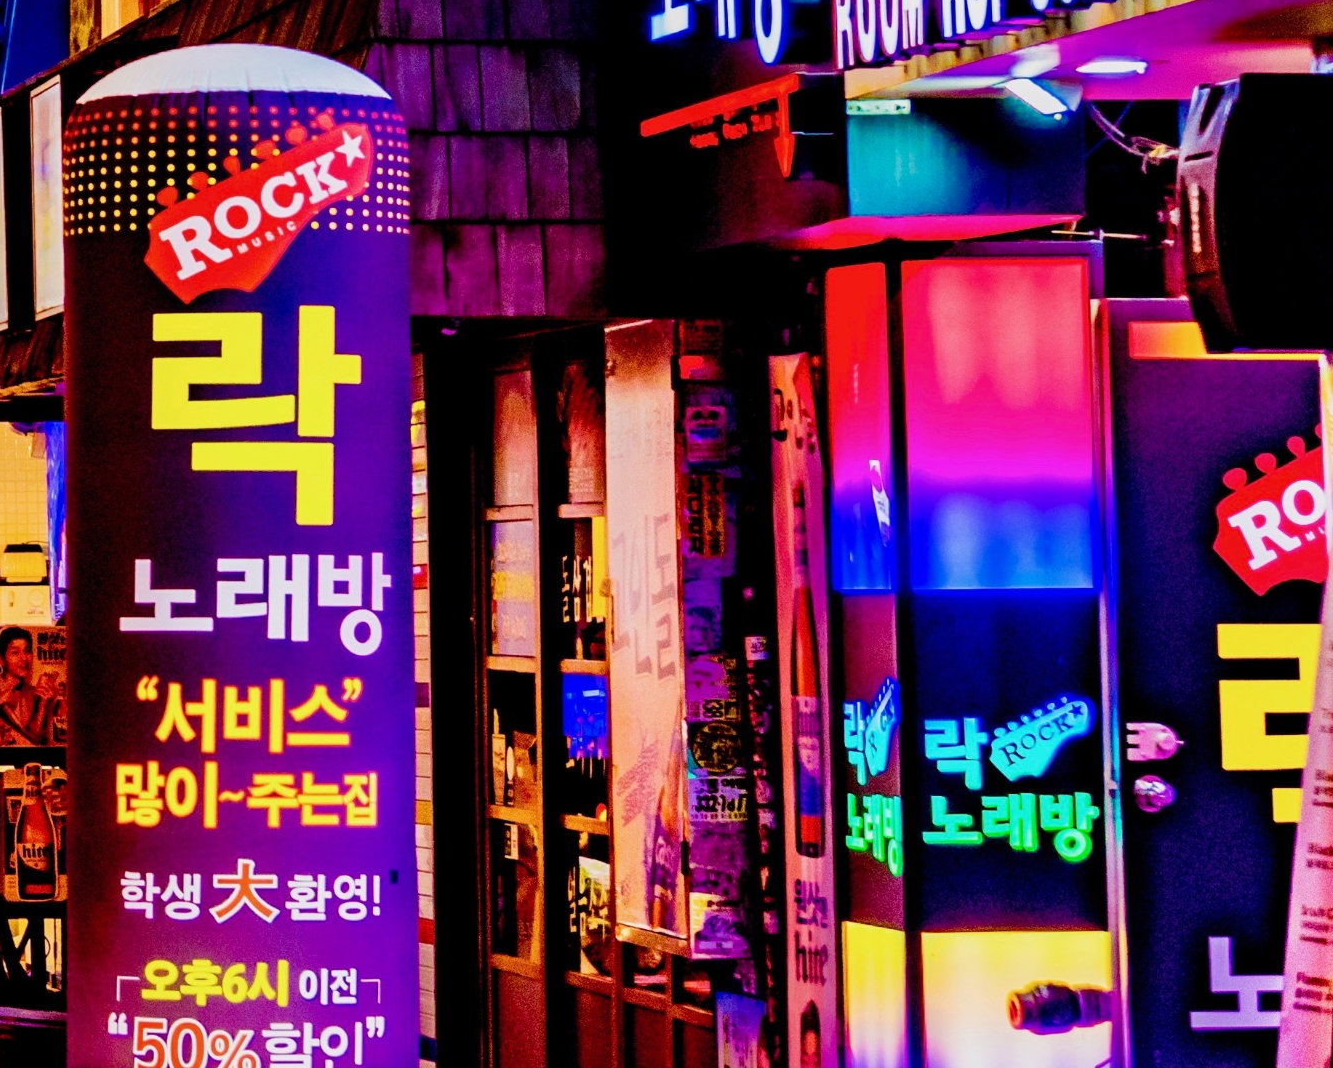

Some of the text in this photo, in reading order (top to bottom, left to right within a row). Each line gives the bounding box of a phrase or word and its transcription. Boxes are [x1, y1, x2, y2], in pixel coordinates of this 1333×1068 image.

[159, 158, 347, 280] ROCK
[236, 219, 298, 255] MUSIC
[152, 305, 362, 525] 락
[119, 553, 392, 656] 노래방
[924, 715, 1073, 790] 락 ROCK
[922, 792, 1100, 863] 노래방
[120, 858, 382, 924] 학생 大 환영!
[140, 958, 358, 1008] 오후6시 이전
